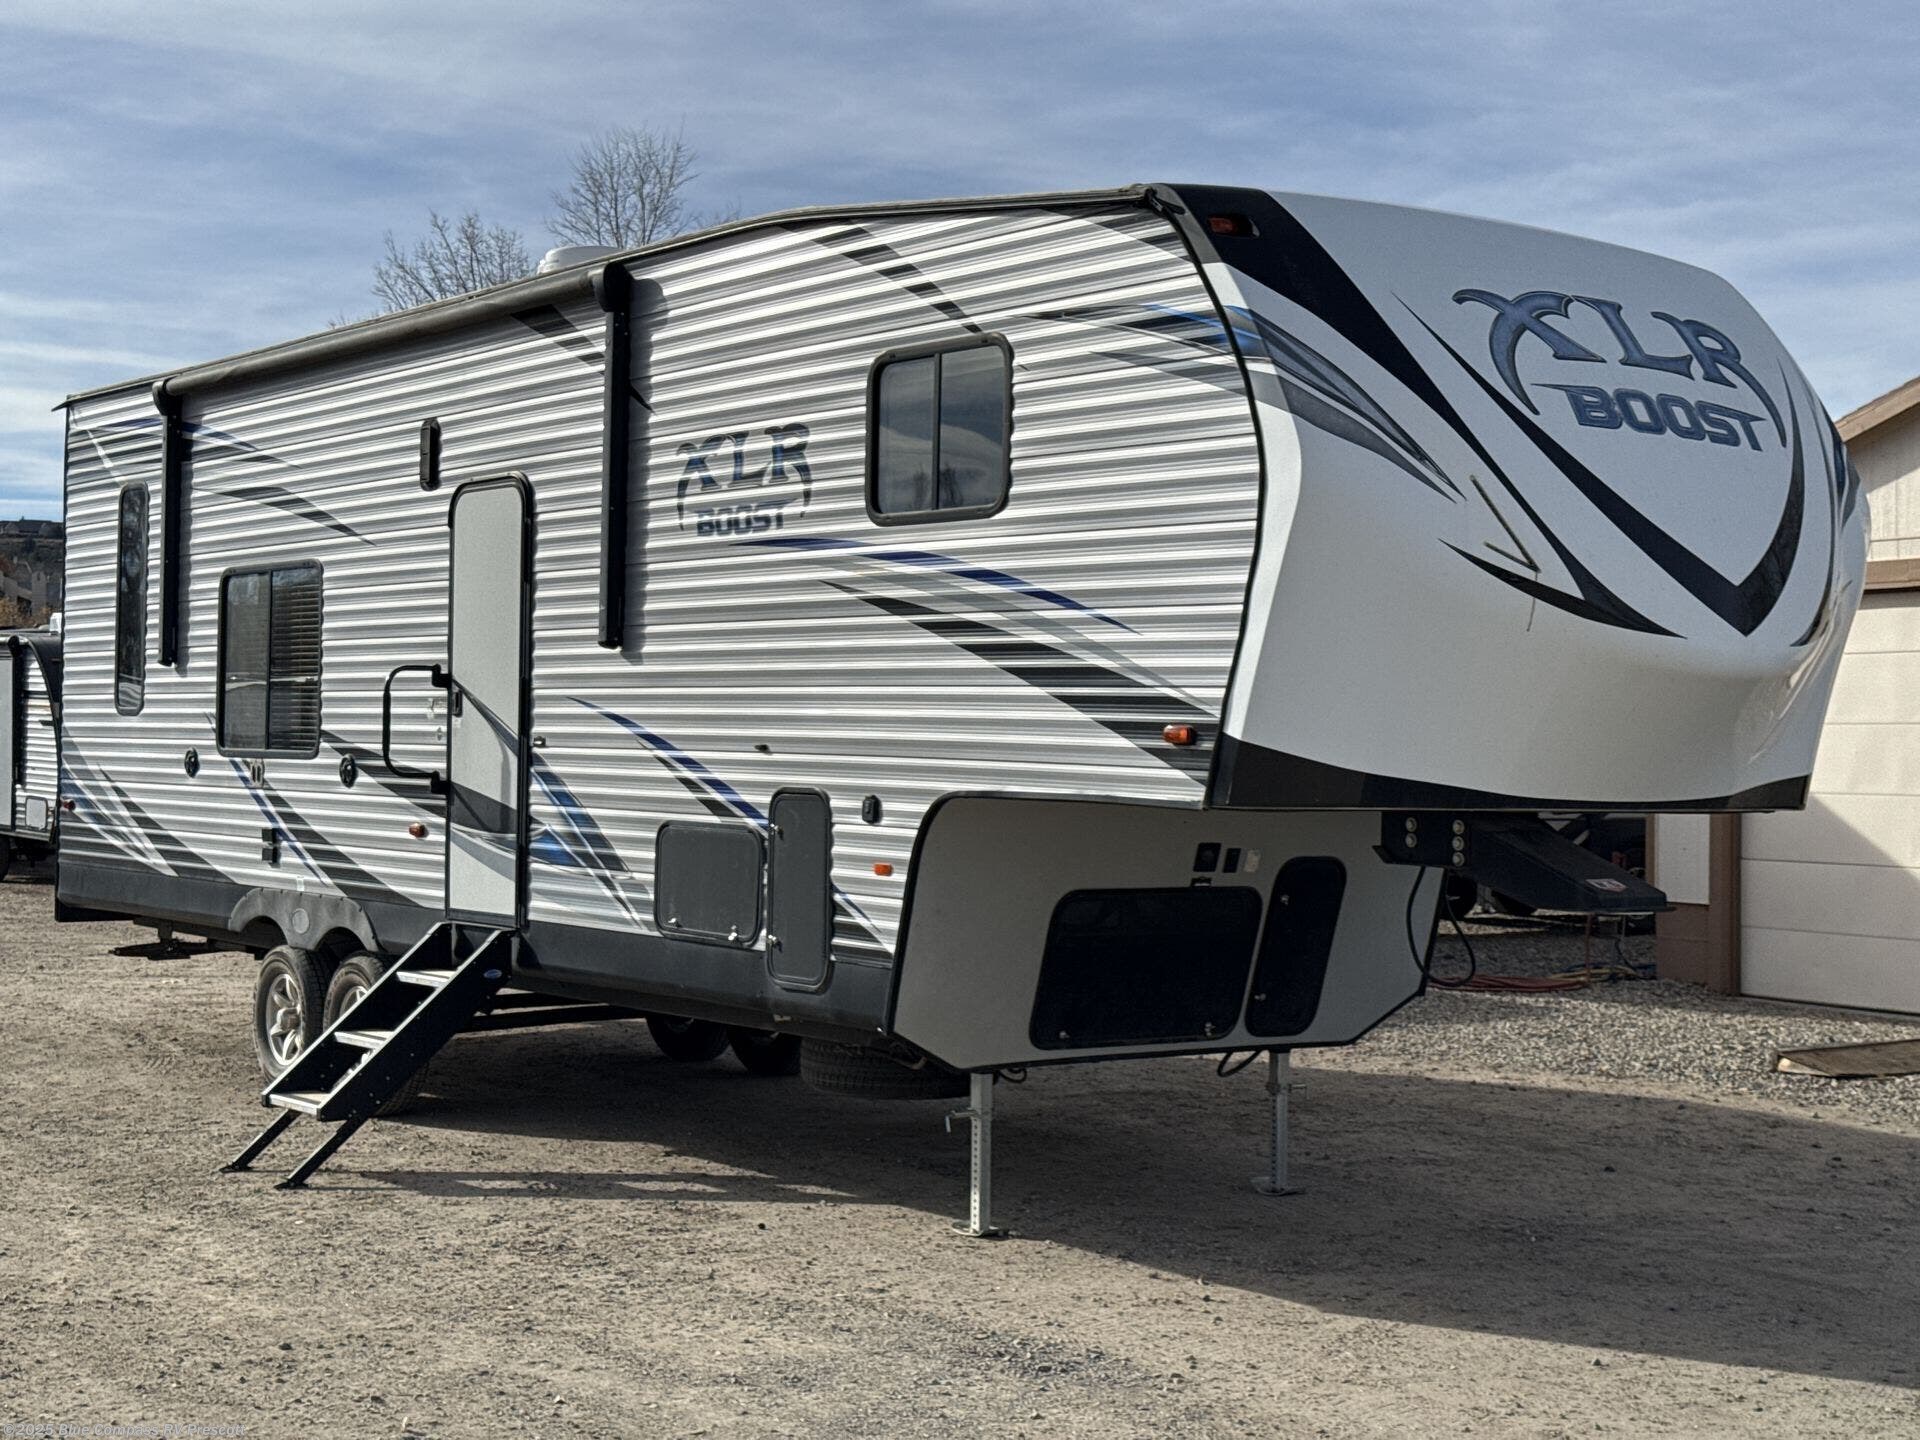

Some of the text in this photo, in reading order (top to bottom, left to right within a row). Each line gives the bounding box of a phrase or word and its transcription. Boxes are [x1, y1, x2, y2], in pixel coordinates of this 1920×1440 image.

[1452, 289, 1787, 448] XLR
[1531, 383, 1767, 452] BOOST
[676, 423, 813, 530] XLR
[689, 498, 798, 536] BOOST
